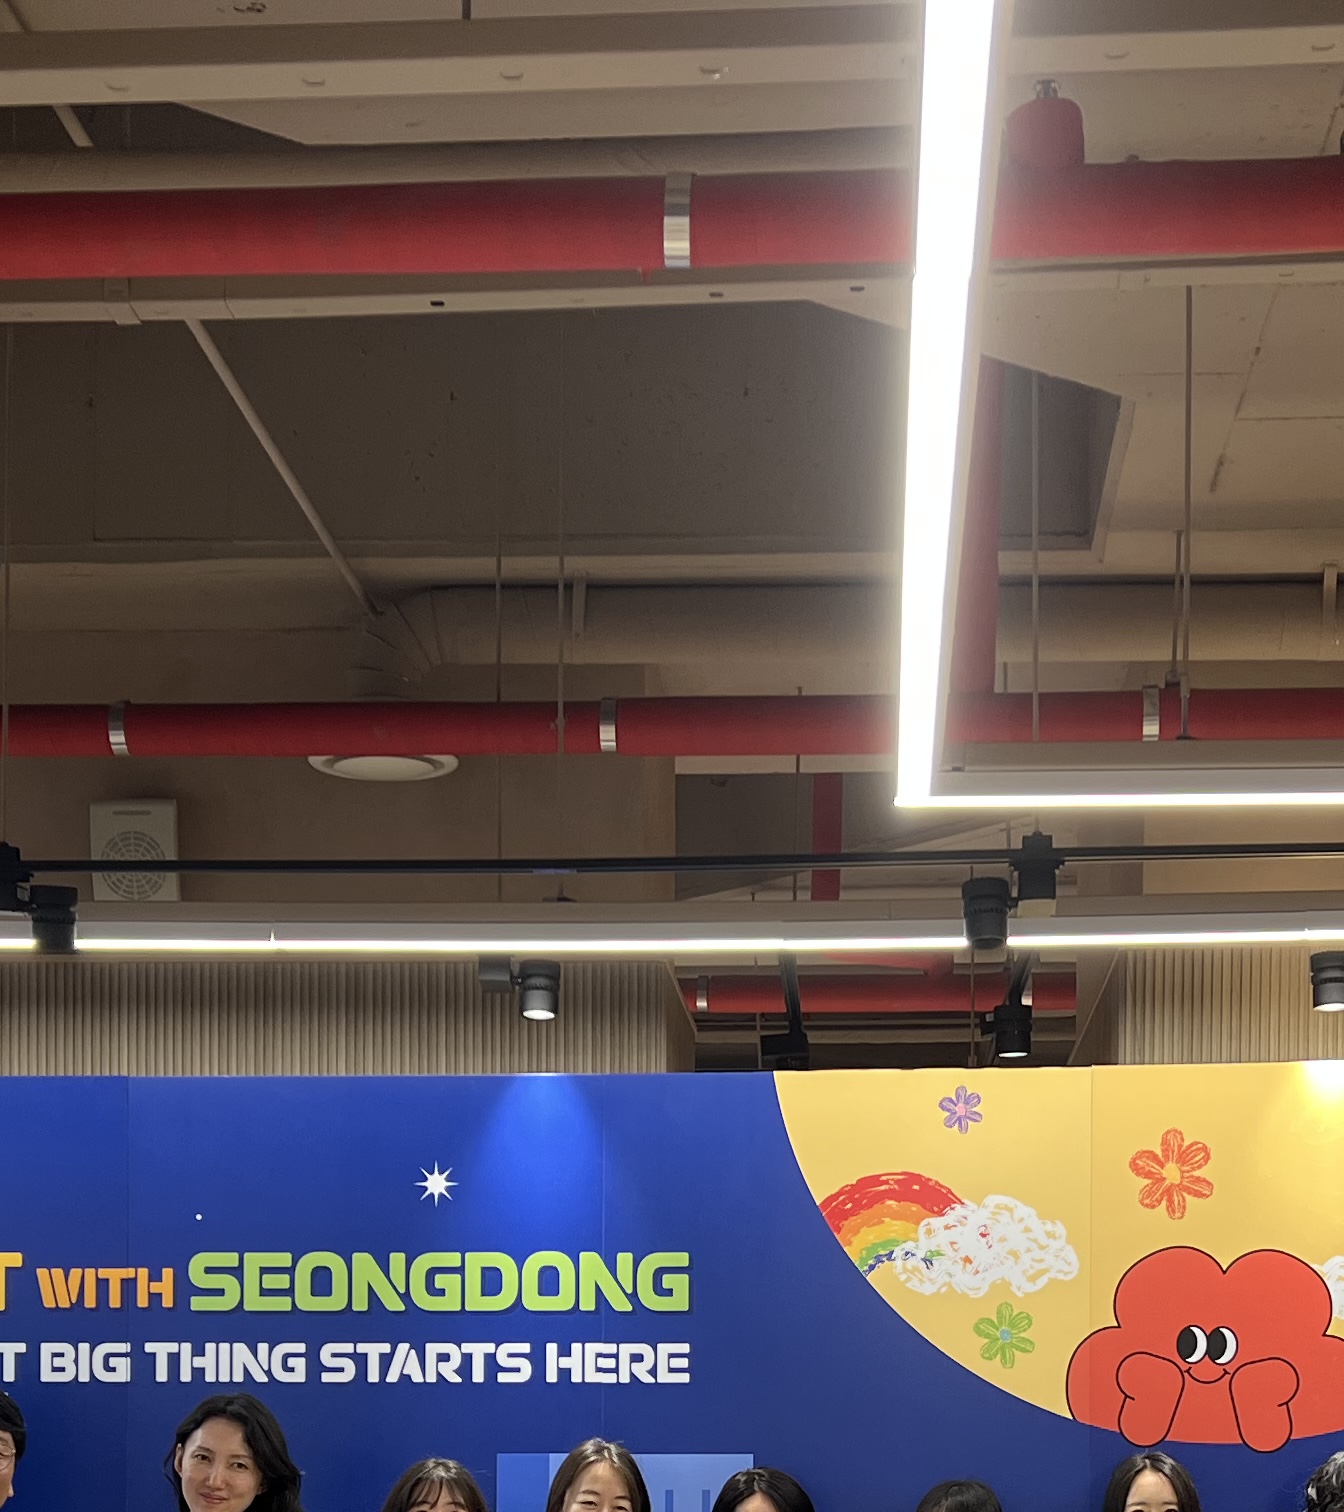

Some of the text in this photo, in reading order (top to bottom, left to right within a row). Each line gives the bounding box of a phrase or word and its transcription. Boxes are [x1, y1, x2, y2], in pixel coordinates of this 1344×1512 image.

[35, 1267, 174, 1309] WITH
[188, 1250, 690, 1312] SEONGDONG
[39, 1341, 131, 1383] BIG
[143, 1341, 307, 1383] THING
[319, 1342, 533, 1384] STARTS
[545, 1342, 691, 1384] HERE
